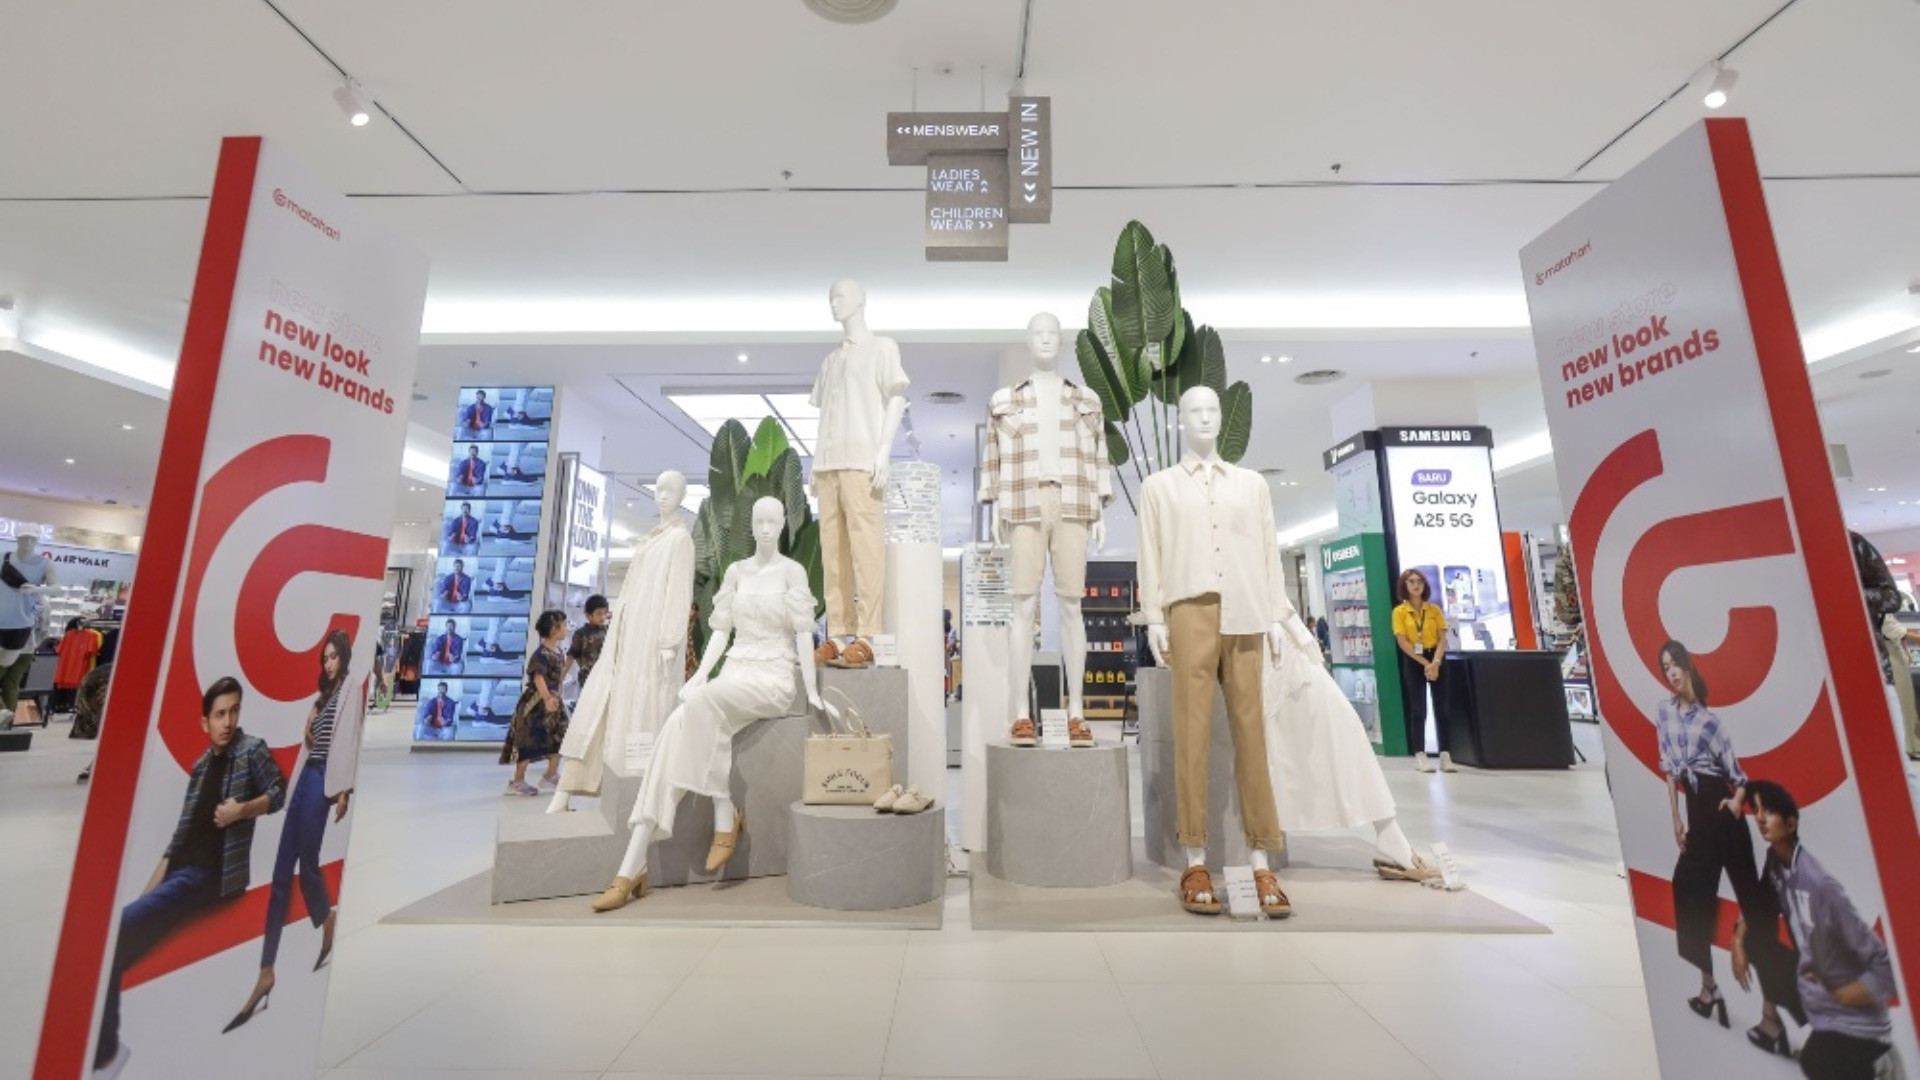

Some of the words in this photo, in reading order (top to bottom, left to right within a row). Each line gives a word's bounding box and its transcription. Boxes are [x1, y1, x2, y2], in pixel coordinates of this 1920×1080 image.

[1021, 103, 1038, 122] IN
[913, 125, 999, 136] MENSWEAR
[1021, 128, 1039, 176] NEW
[932, 169, 980, 180] LADIES
[931, 181, 974, 192] WEAR
[286, 198, 341, 242] matahari
[930, 208, 1003, 218] CHILDREN
[930, 219, 974, 230] WEAR
[1544, 239, 1593, 279] matahari
[264, 309, 321, 351] new
[322, 333, 371, 377] look
[1561, 345, 1608, 382] new
[1612, 314, 1671, 359] look
[258, 339, 316, 381] new
[318, 361, 395, 414] brands
[1566, 373, 1614, 408] new
[1618, 328, 1720, 387] brands
[1399, 430, 1472, 442] SAMSUNG
[1417, 472, 1447, 483] BARU
[1412, 490, 1477, 507] Galaxy
[1413, 513, 1445, 528] A25
[1449, 513, 1474, 528] 5G
